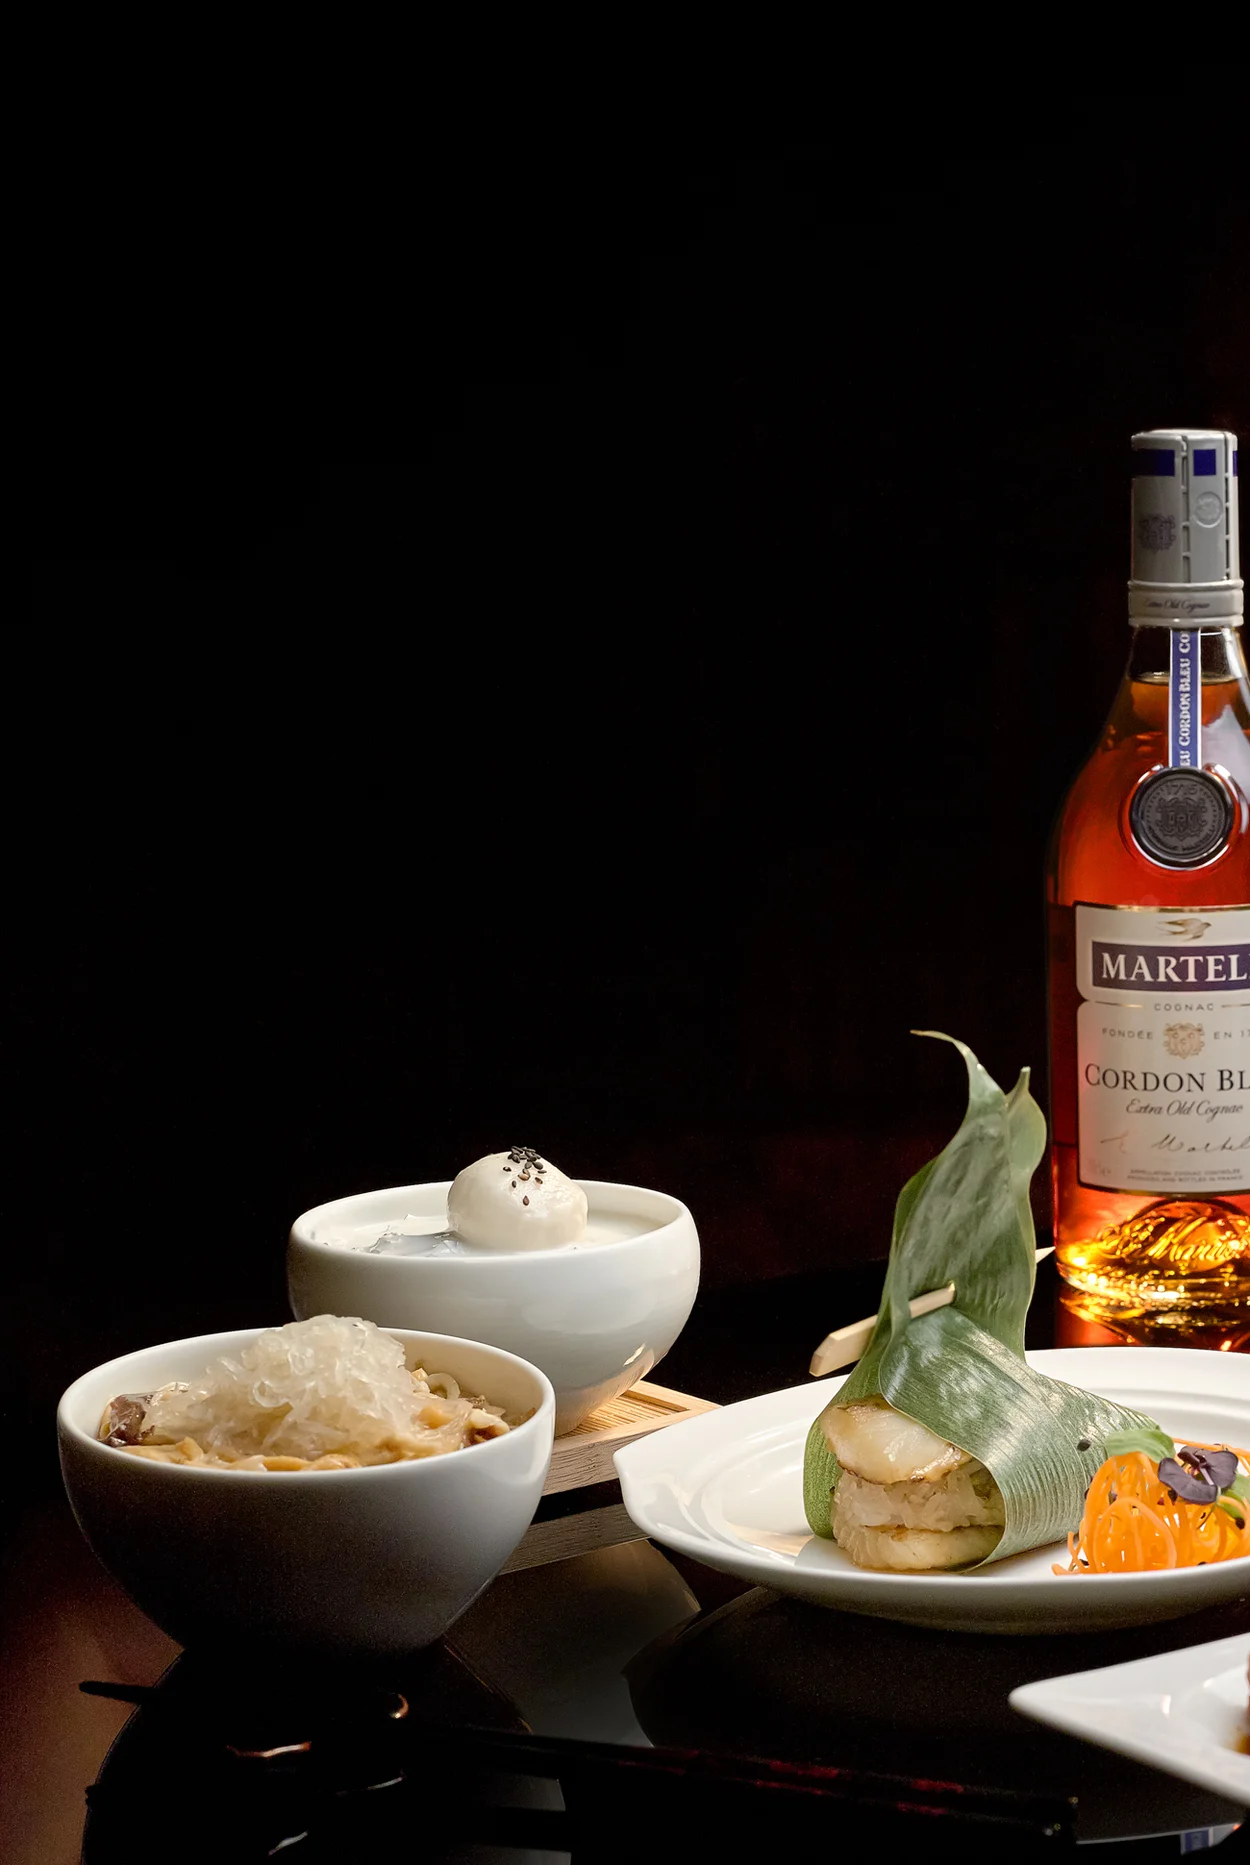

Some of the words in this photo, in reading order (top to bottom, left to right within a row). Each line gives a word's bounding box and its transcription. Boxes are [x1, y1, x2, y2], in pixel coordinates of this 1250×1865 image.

[1178, 658, 1191, 693] BLEU
[1178, 692, 1191, 747] CORDON
[1154, 1003, 1215, 1012] COGNAC
[1101, 1027, 1154, 1040] FONDÉE
[1214, 1030, 1233, 1039] EN
[1084, 1063, 1206, 1093] CORDON
[1125, 1098, 1163, 1115] Extra
[1166, 1099, 1194, 1116] Old
[1195, 1100, 1244, 1123] Cognac
